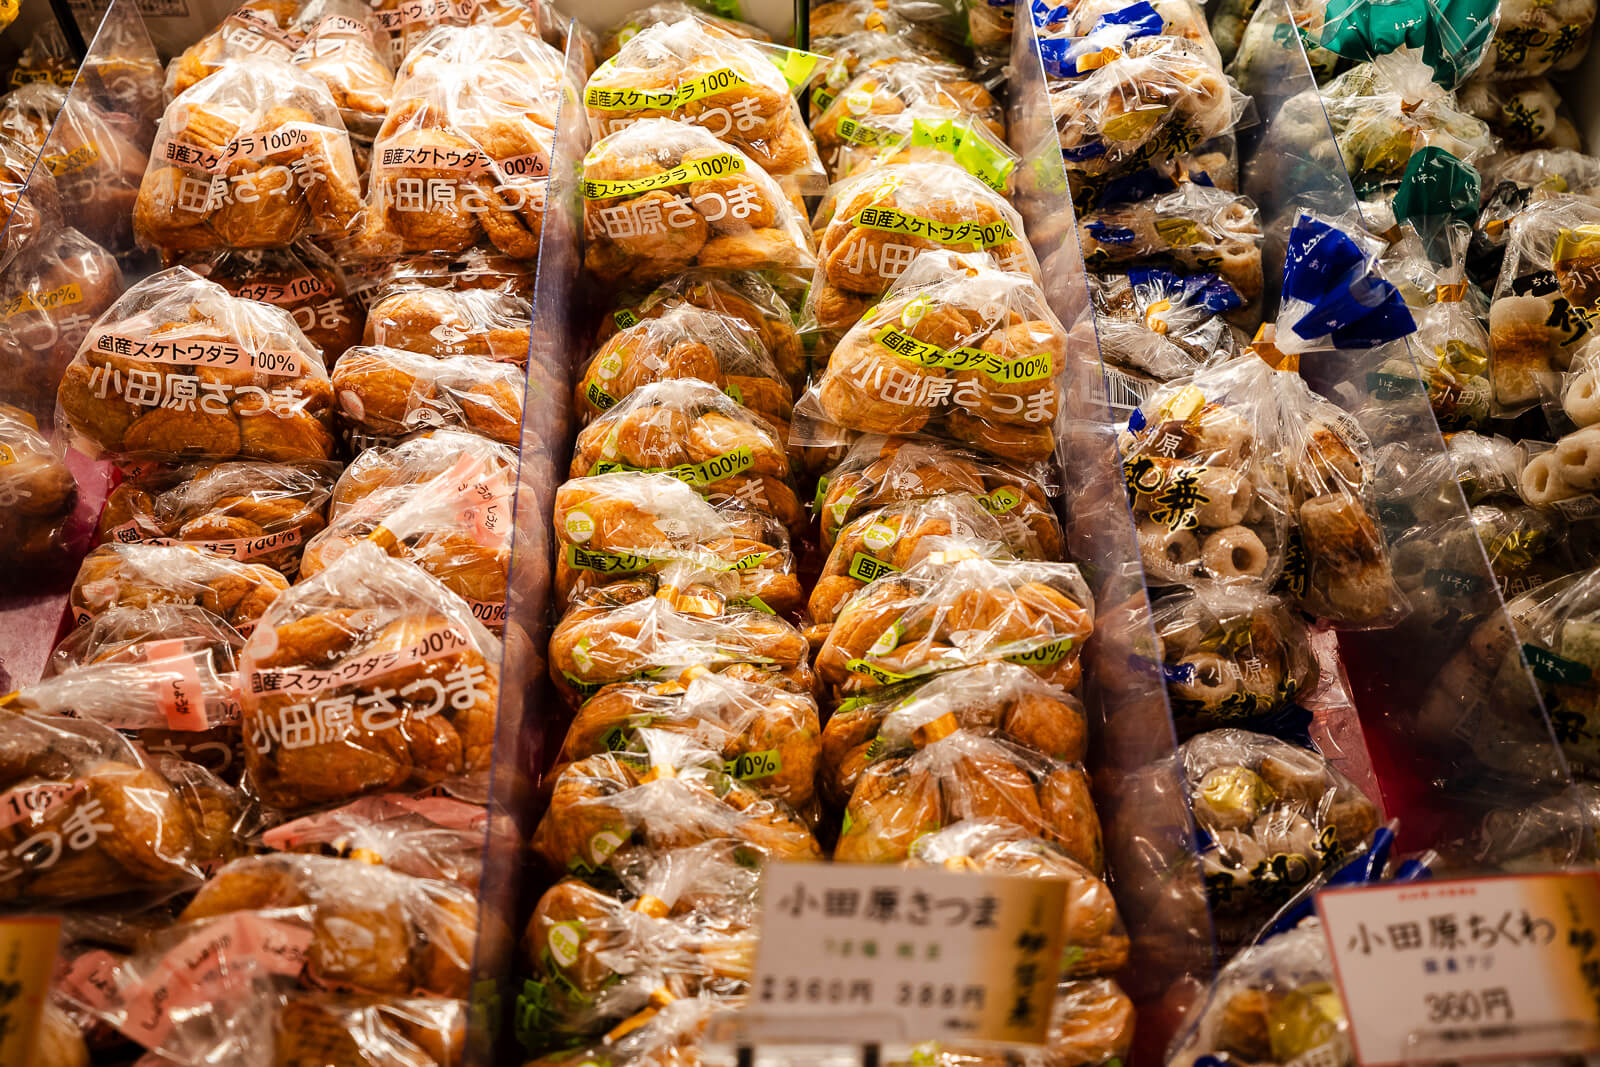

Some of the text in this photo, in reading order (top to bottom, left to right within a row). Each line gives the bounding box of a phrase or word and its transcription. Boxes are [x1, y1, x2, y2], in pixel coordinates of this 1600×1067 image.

[260, 129, 307, 152] 100%
[153, 152, 327, 214] 小田原さつま
[504, 155, 543, 176] 00%
[693, 155, 740, 177] 100%
[98, 334, 295, 373] 国産スケトウダラ 100%
[882, 331, 1048, 379] 国産スケウダラ 100%
[88, 361, 306, 419] 小田原さつま
[851, 355, 1055, 422] 小田原さつま
[700, 451, 749, 482] 100%
[251, 664, 490, 755] 小田原さつま
[777, 882, 998, 929] 小田原さつま
[1348, 909, 1556, 957] 小田原ちくわ
[1423, 986, 1515, 1023] 360円
